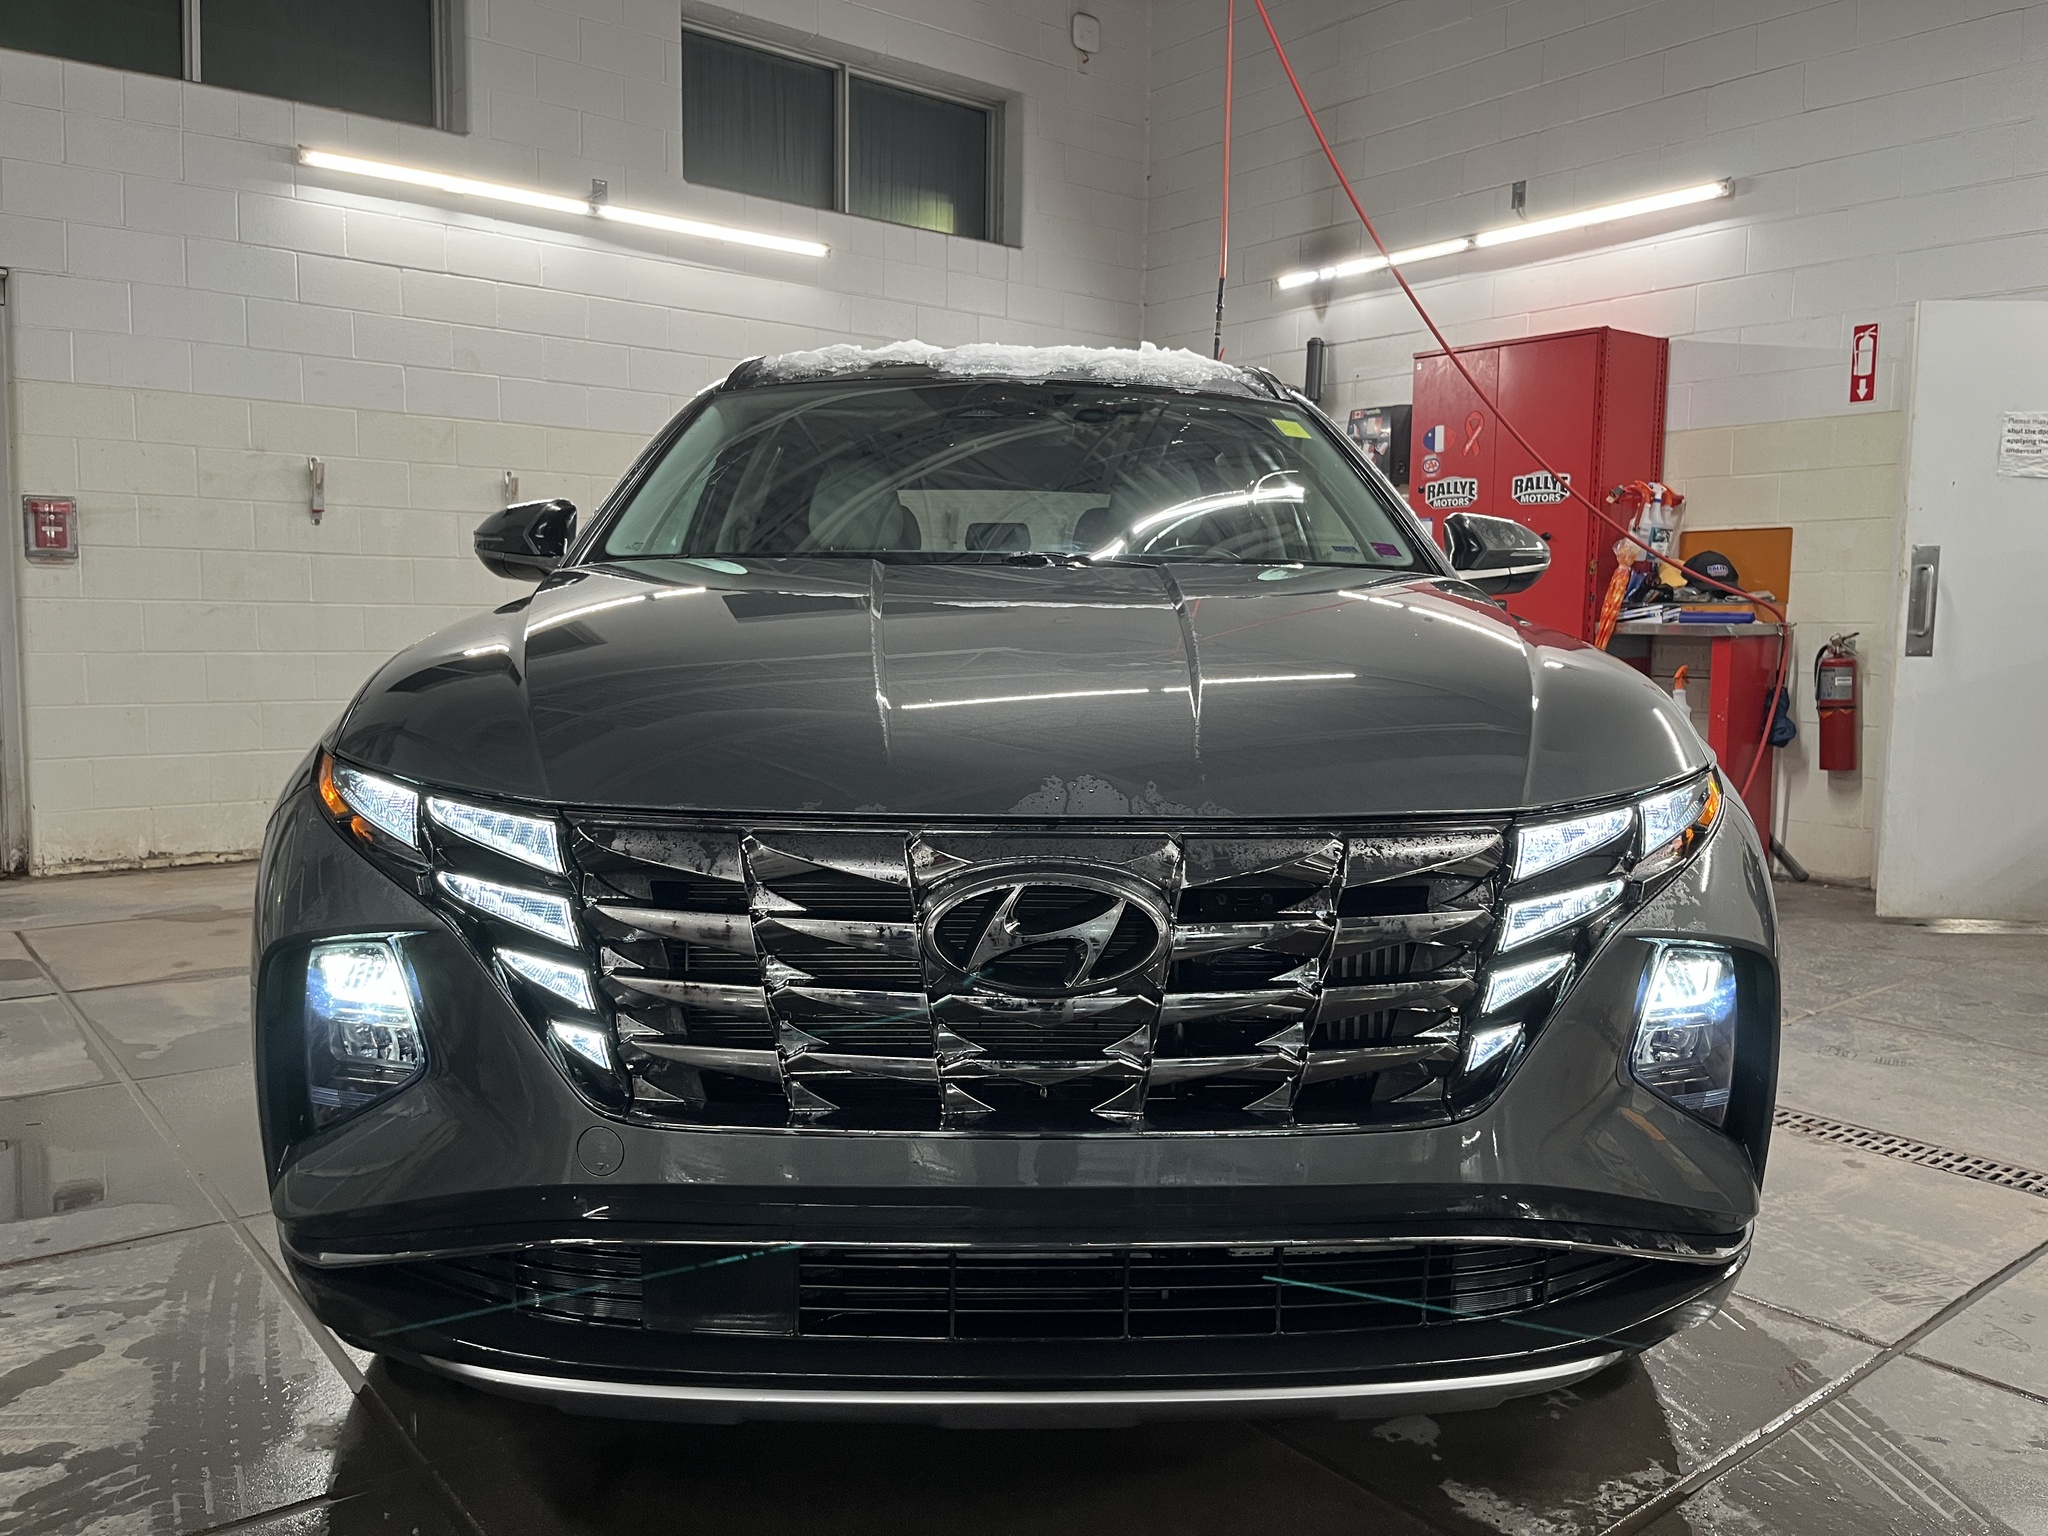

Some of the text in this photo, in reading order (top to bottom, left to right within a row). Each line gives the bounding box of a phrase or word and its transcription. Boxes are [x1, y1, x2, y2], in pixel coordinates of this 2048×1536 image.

[1427, 481, 1476, 500] RALLYE
[1432, 497, 1470, 508] MOTORS
[1520, 493, 1561, 503] MOTORS
